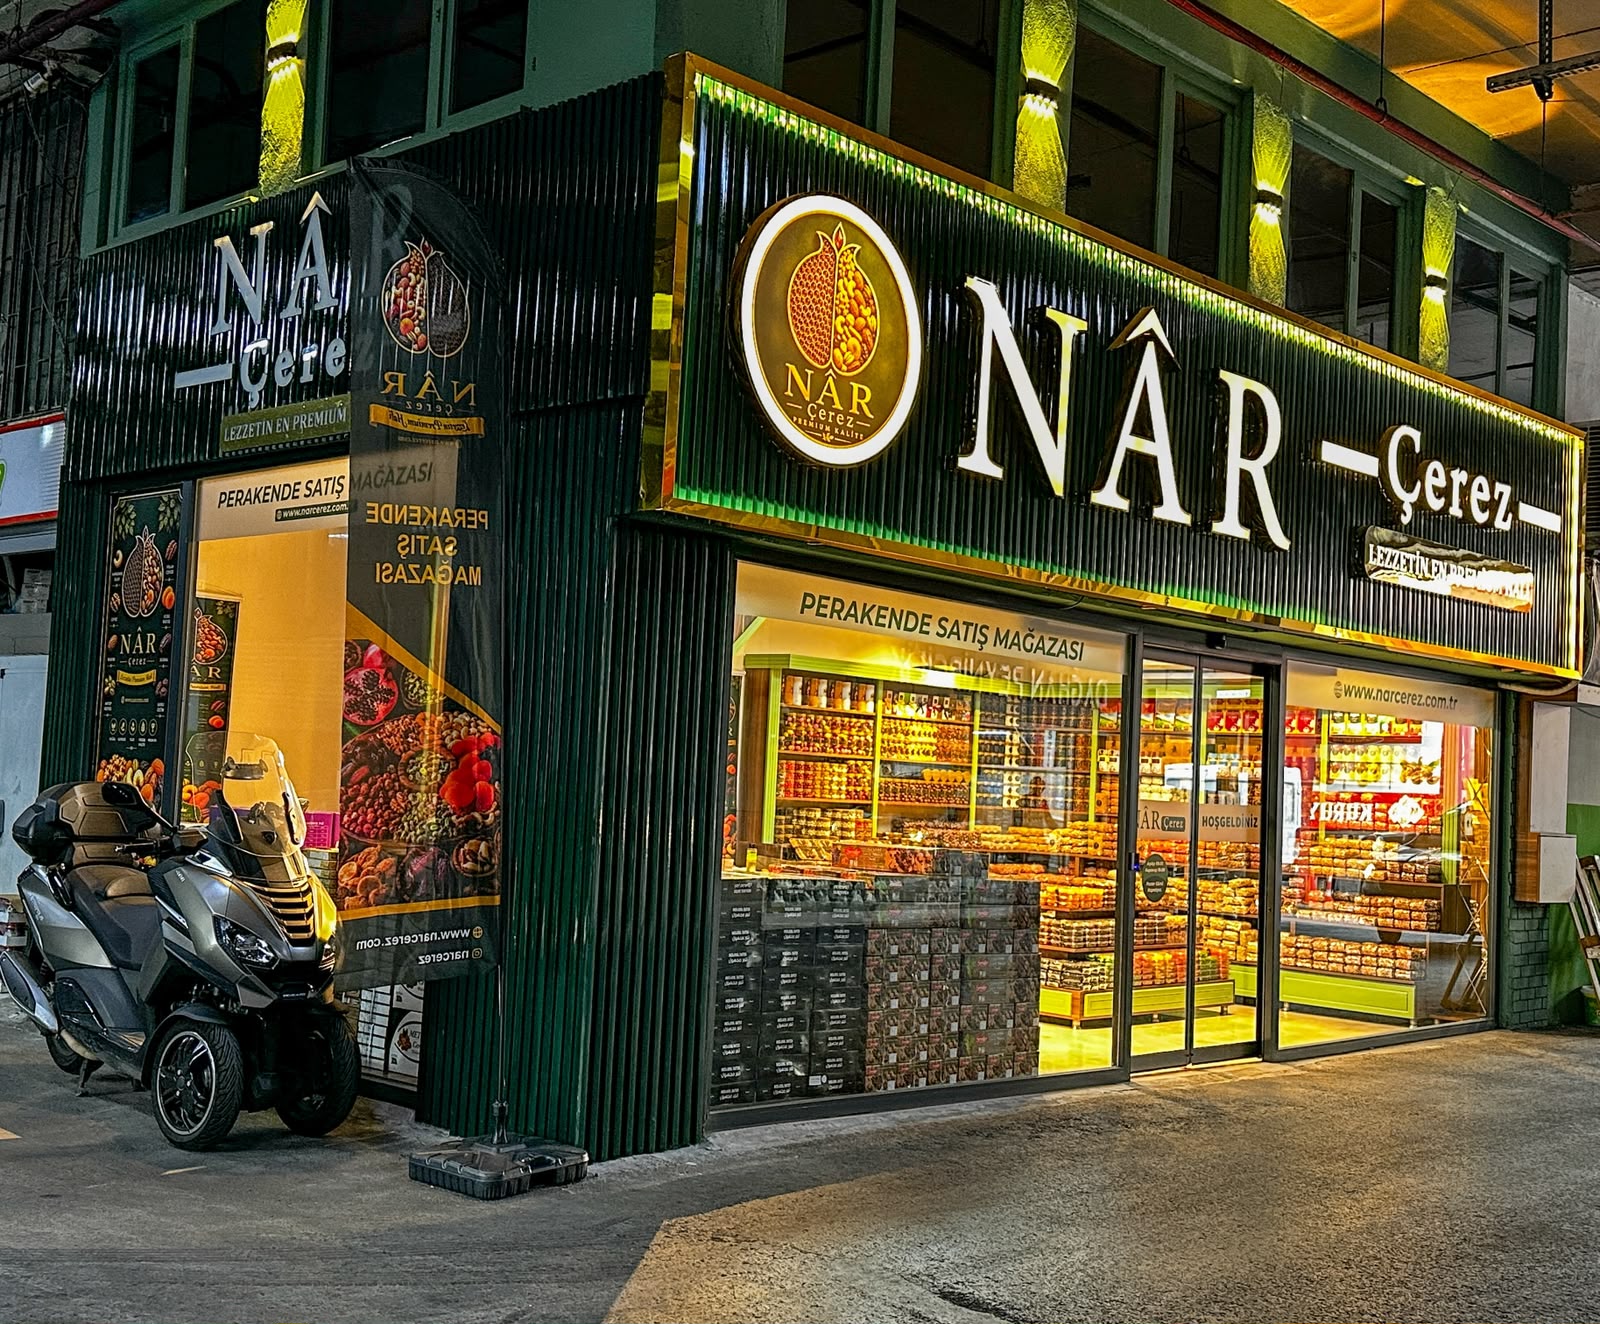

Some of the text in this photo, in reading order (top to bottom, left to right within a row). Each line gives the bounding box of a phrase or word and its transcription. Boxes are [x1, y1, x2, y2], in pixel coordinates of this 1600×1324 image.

[784, 363, 874, 419] NÂR
[276, 416, 290, 433] EN
[793, 416, 830, 431] PREMIUM
[807, 403, 854, 428] Çerez
[958, 276, 1291, 551] NÂR
[218, 481, 301, 508] PERAKENDE
[303, 475, 345, 499] SATIŞ
[1387, 425, 1513, 532] Çerez
[1369, 543, 1429, 577] LEZZETİN
[120, 626, 156, 654] NÂR
[800, 591, 1084, 661] PERAKENDE SATIŞ MAĞAZASI
[1344, 683, 1458, 710] www.narcerez.com.tr
[1138, 806, 1184, 831] ÂR Çerez
[1202, 813, 1258, 830] HOŞGELDİNİZ
